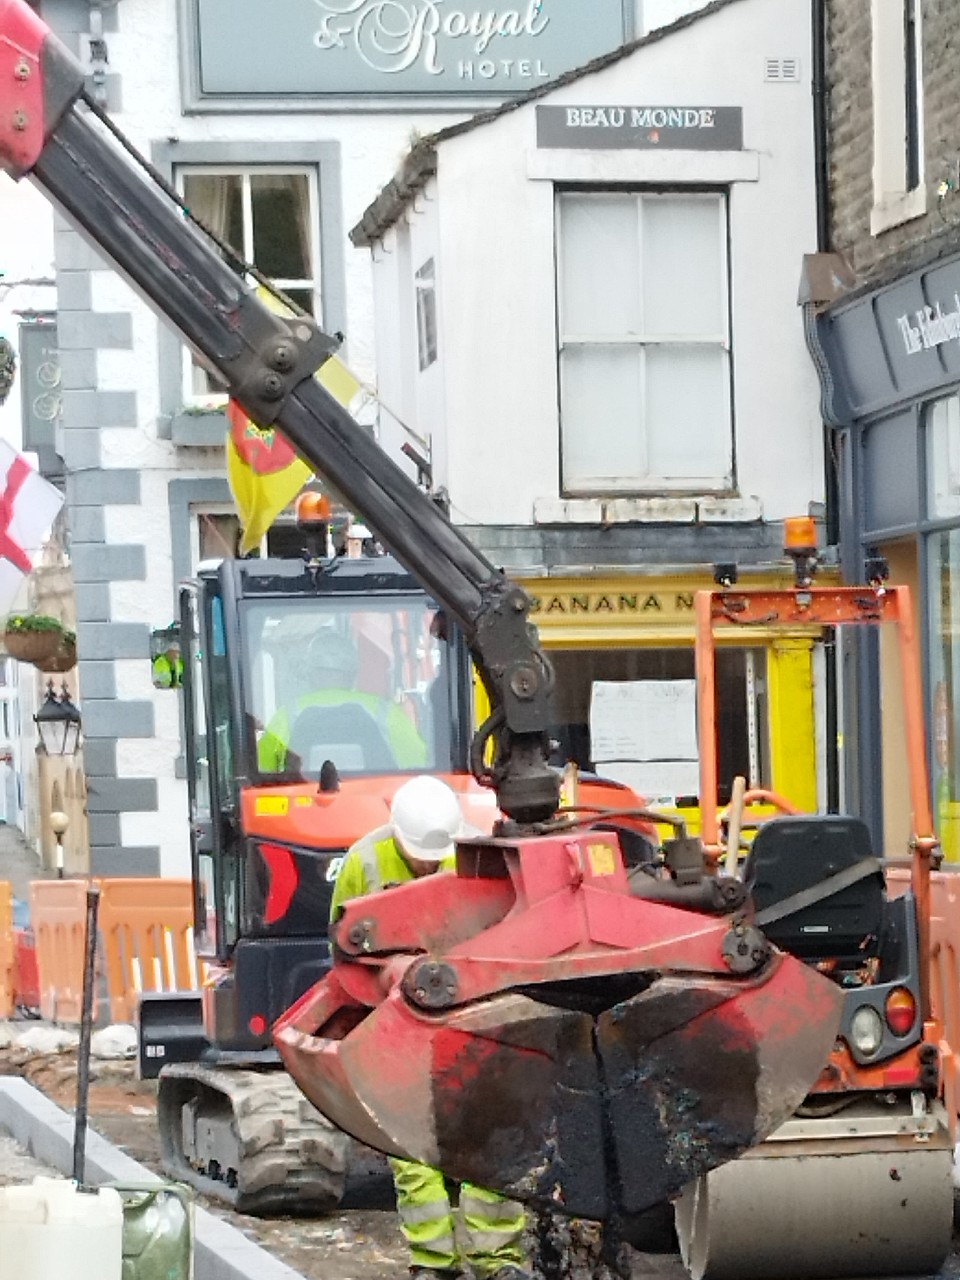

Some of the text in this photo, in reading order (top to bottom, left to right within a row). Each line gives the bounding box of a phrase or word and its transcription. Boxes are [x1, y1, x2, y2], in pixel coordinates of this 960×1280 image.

[313, 0, 550, 75] & Royal
[458, 59, 550, 80] HOTEL
[565, 107, 715, 127] BEAU MONDE
[897, 314, 923, 355] The
